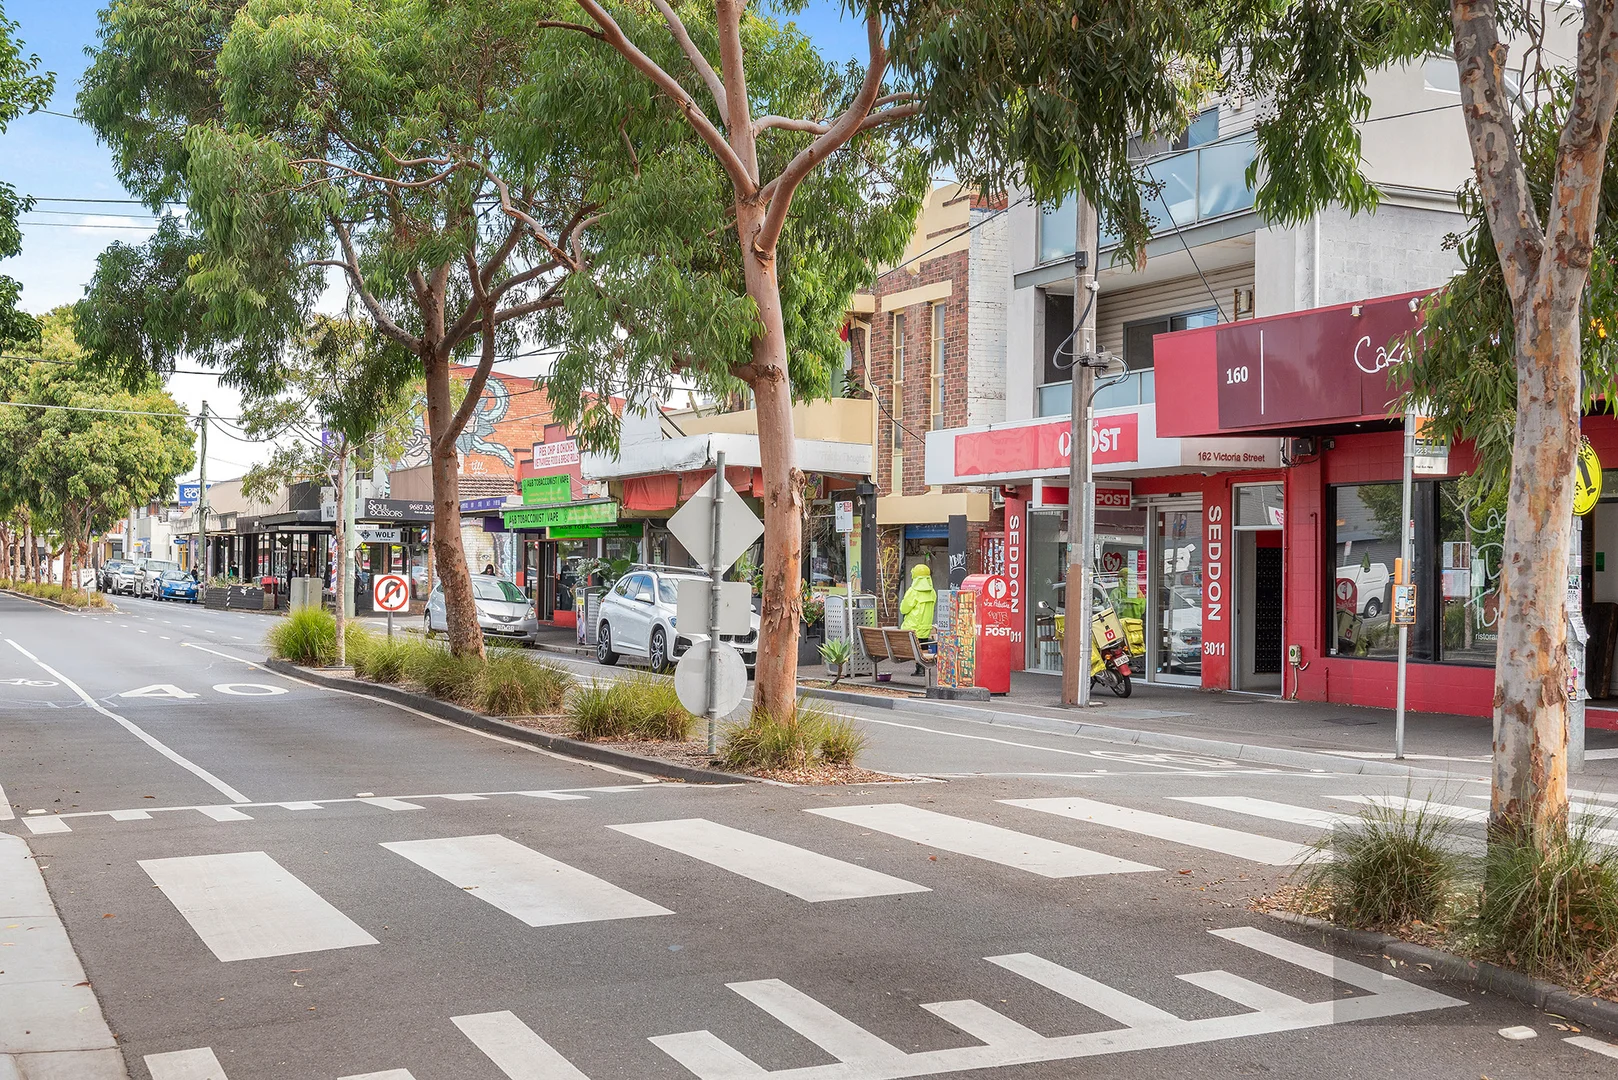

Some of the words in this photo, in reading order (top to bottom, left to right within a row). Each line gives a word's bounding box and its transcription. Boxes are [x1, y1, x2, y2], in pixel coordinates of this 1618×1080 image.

[1226, 365, 1249, 385] 160
[1091, 427, 1121, 453] OST
[1198, 452, 1212, 460] 162
[1213, 452, 1240, 462] Victoria
[1242, 452, 1265, 462] Street
[1096, 494, 1128, 505] POST
[548, 512, 559, 522] VAPE
[1009, 515, 1020, 613] SEDDON
[1208, 505, 1222, 620] SEDDON
[985, 627, 1012, 636] POST
[1010, 631, 1022, 642] 011
[1204, 642, 1225, 656] 3011
[118, 683, 289, 698] 40
